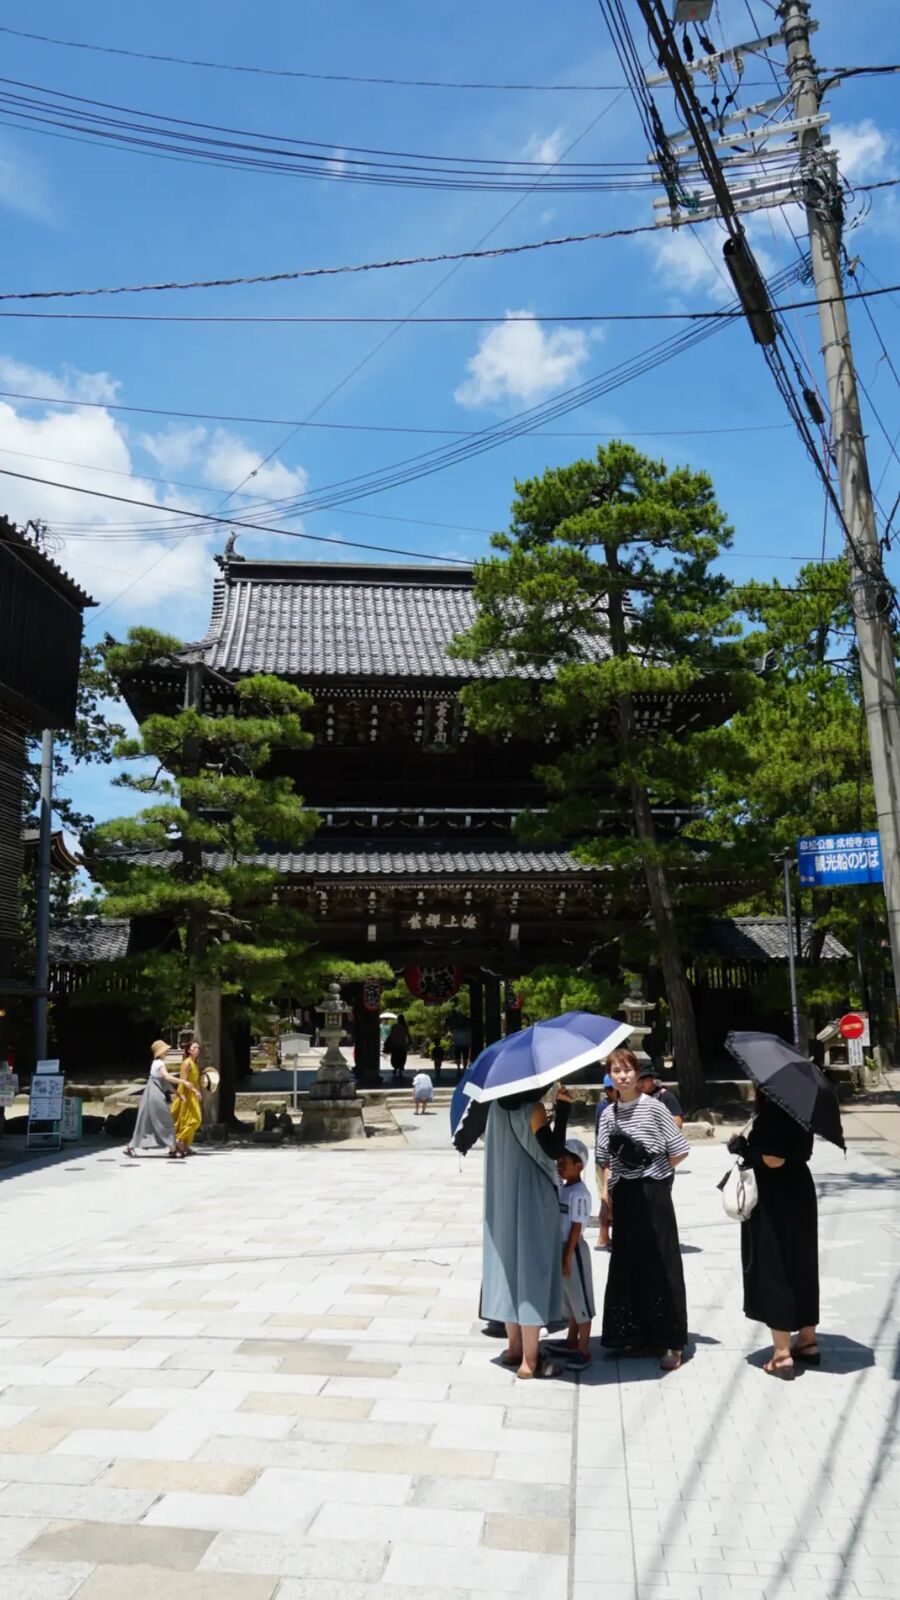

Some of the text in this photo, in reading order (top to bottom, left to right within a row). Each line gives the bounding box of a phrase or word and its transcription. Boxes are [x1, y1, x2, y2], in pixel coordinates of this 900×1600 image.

[815, 851, 879, 872] 観光船のりば
